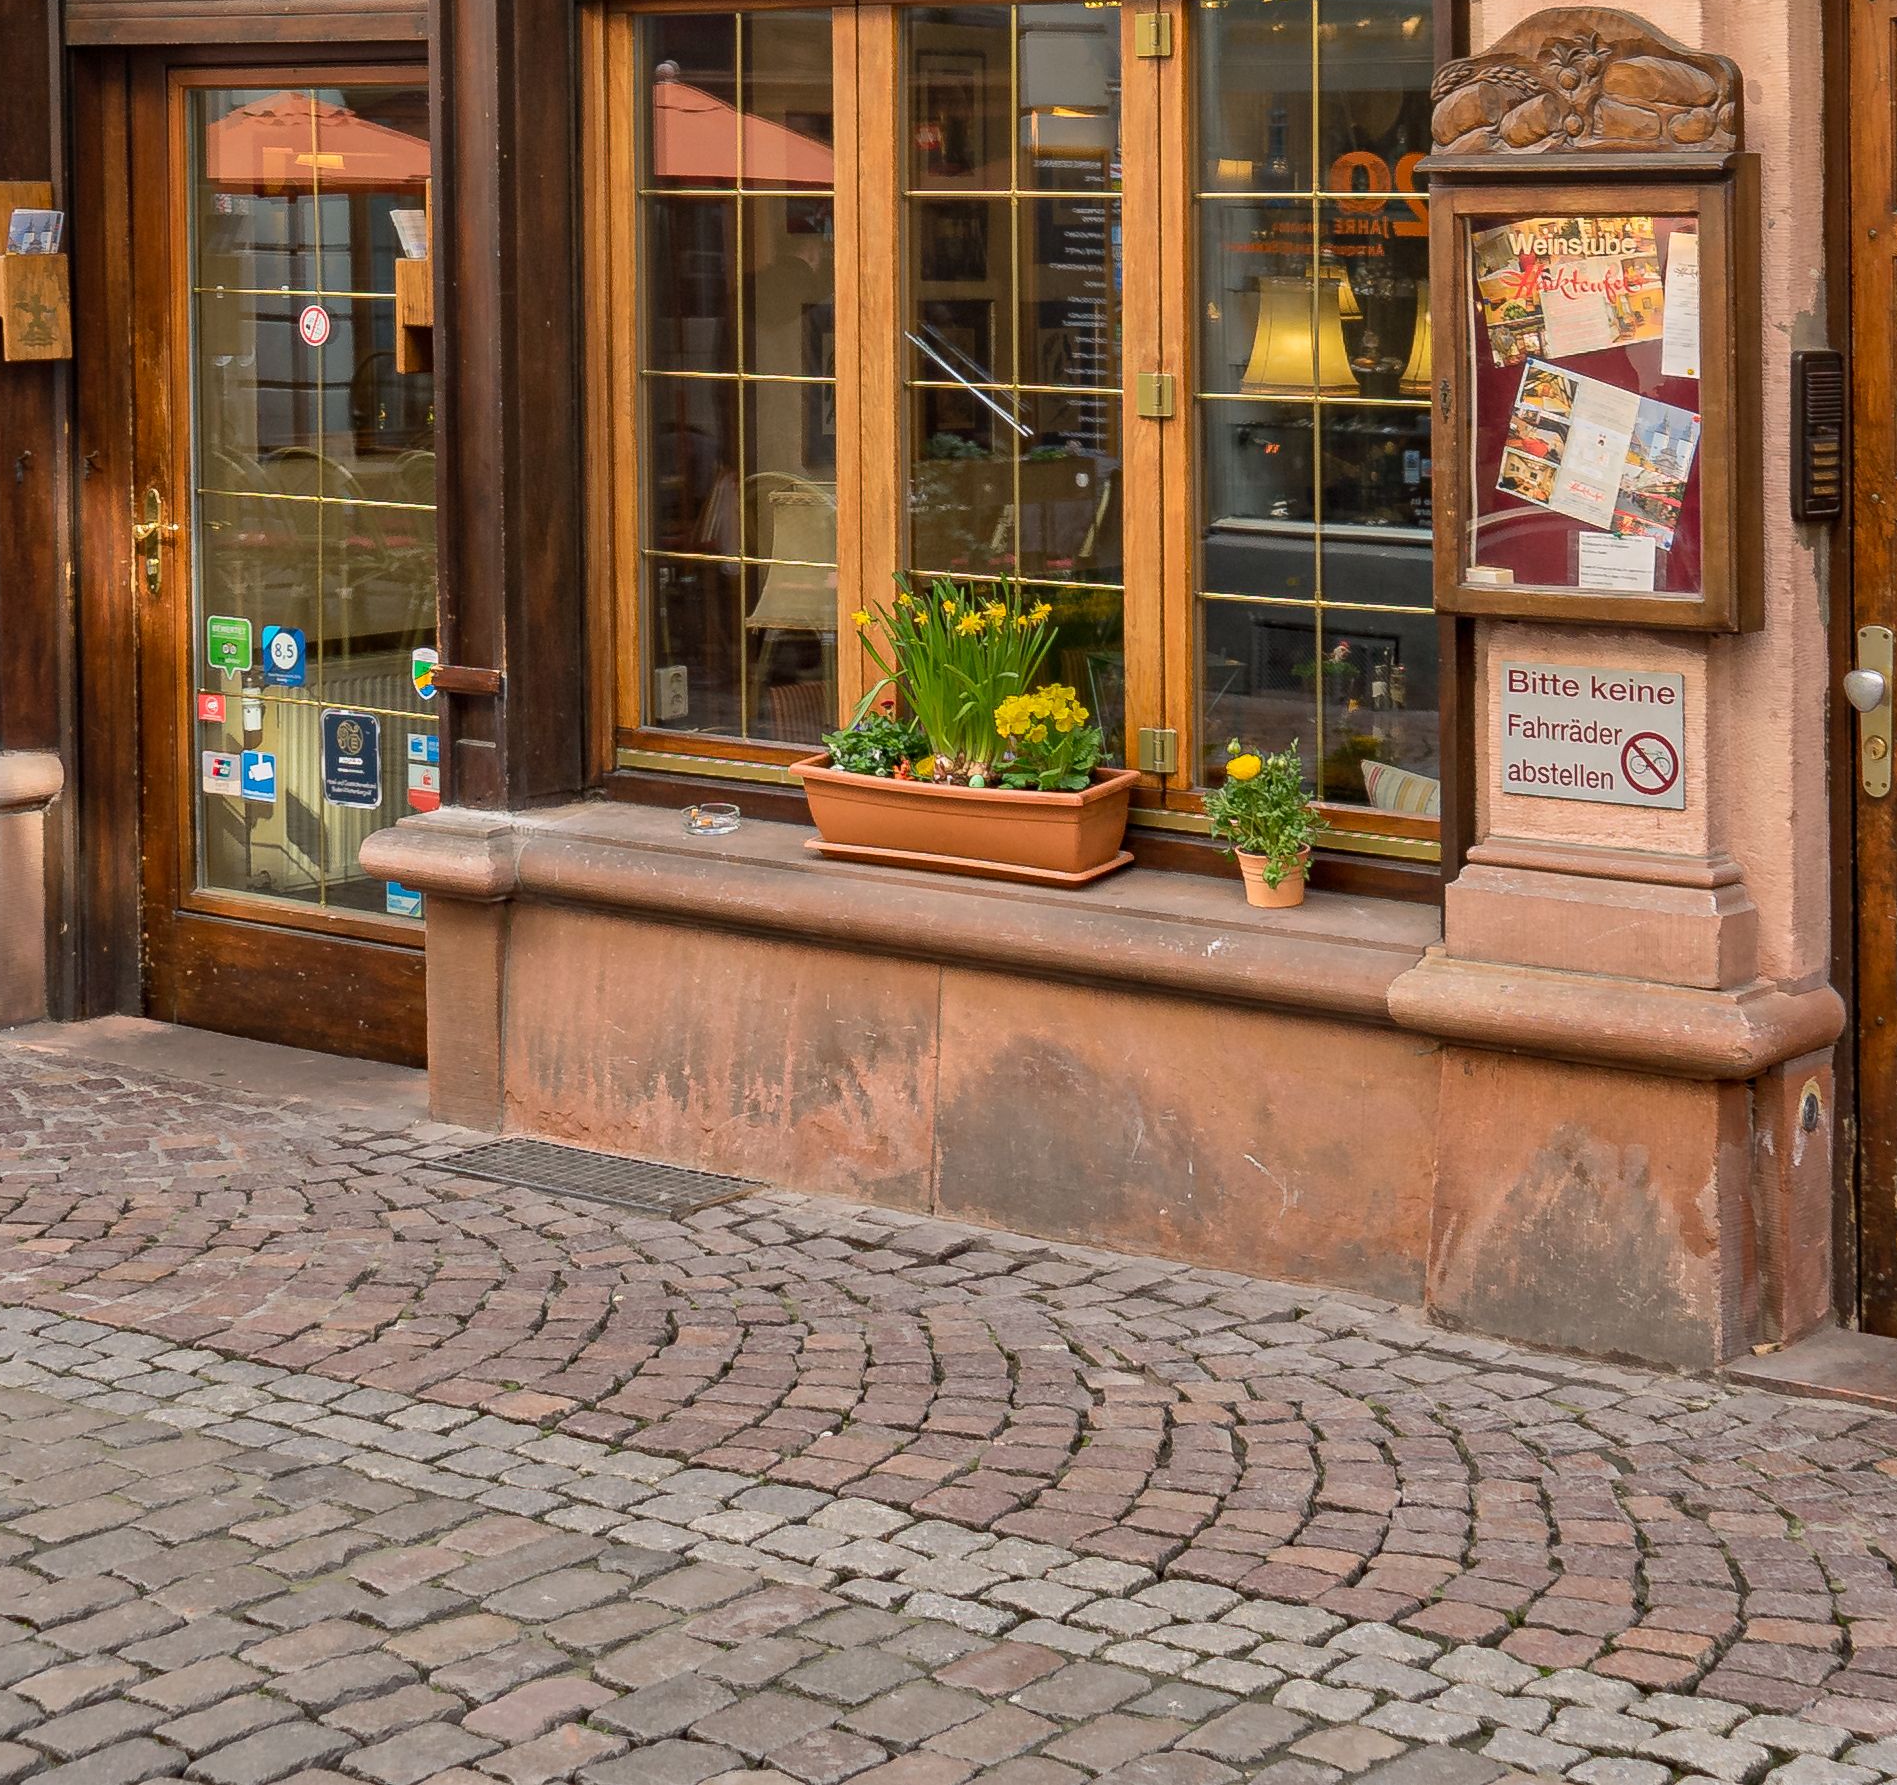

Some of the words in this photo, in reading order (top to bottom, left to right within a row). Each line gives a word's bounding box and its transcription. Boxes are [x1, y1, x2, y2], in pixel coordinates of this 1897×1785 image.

[1509, 228, 1637, 256] Weinstube
[1499, 262, 1644, 304] Hackteufel
[274, 642, 294, 659] 8,5
[1507, 669, 1580, 698] Bitte
[1591, 675, 1676, 705] keine
[1508, 714, 1623, 746] Fahrräder
[1508, 760, 1614, 791] abstellen
